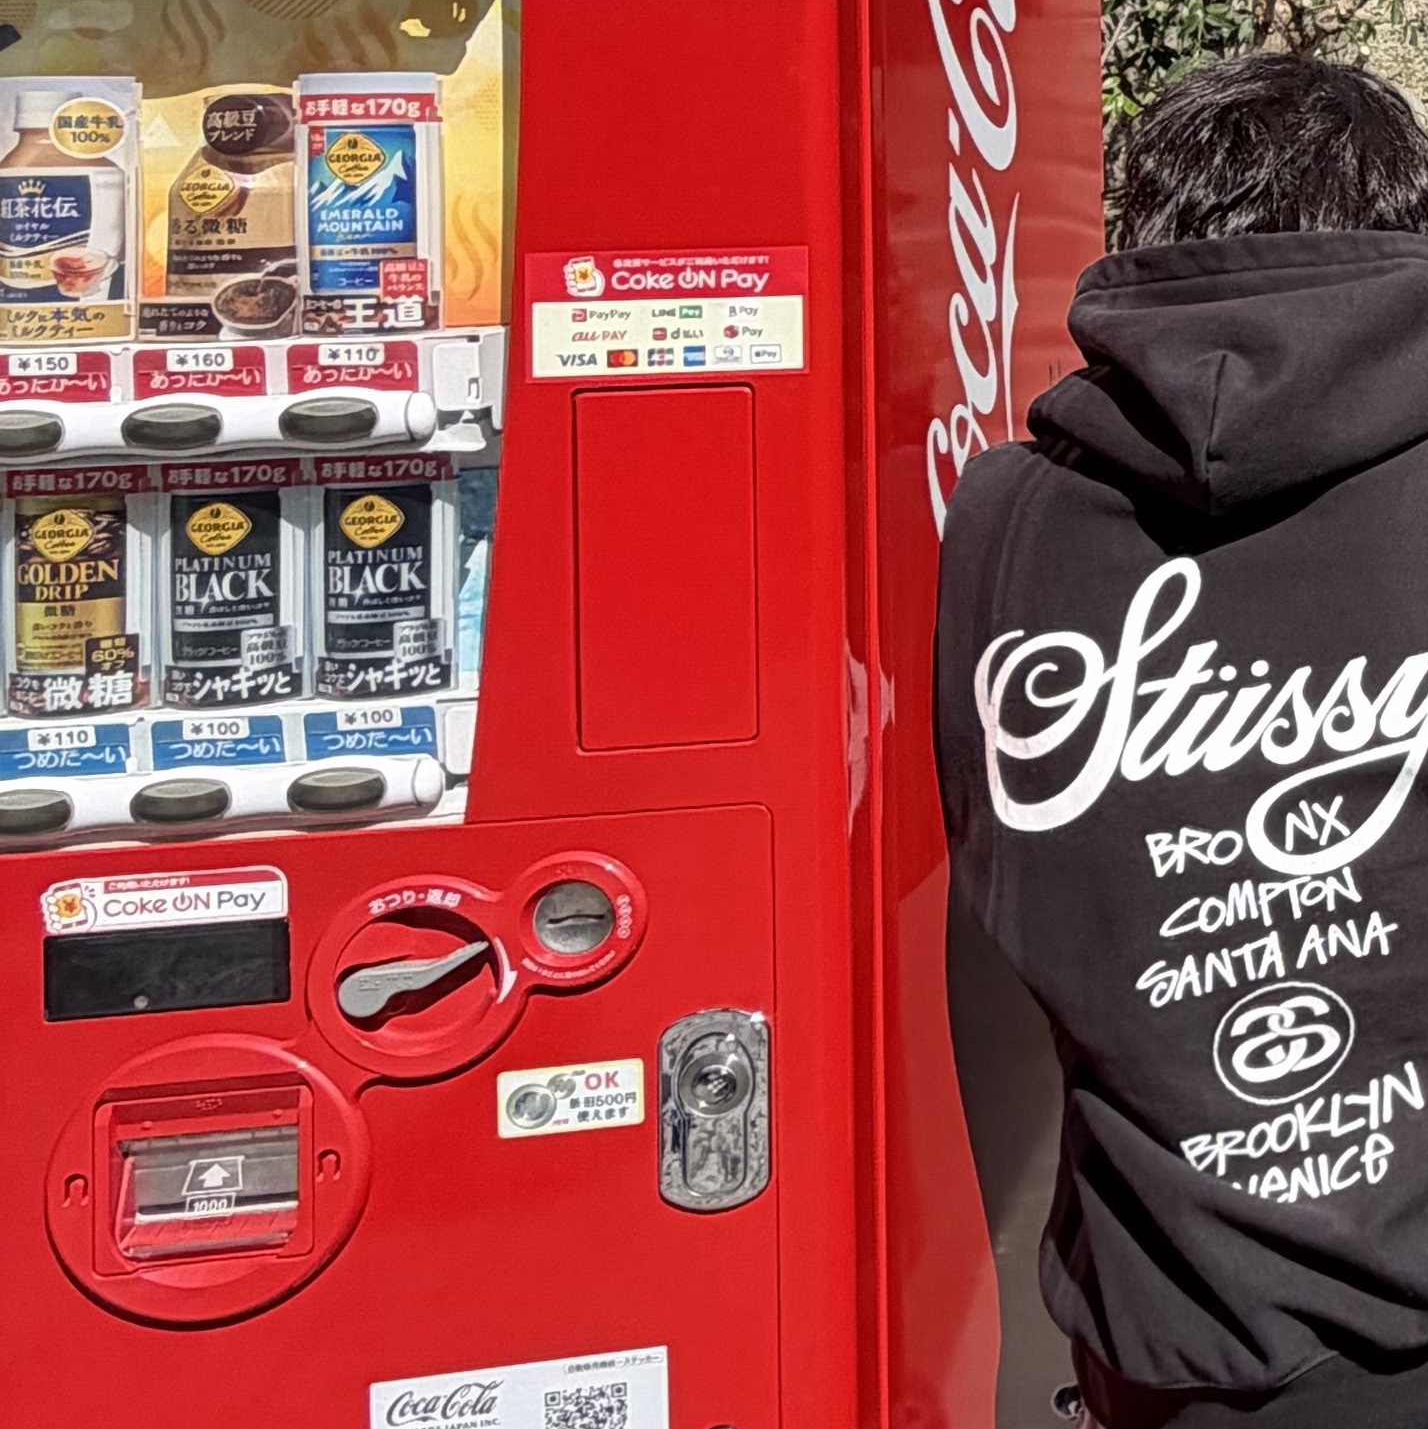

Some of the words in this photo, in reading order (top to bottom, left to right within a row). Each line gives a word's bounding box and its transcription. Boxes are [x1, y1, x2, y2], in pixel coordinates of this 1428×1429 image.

[70, 130, 112, 144] 100%
[208, 128, 255, 142] ブレンド
[327, 152, 384, 165] GEORGIA
[319, 207, 400, 222] EMERALD
[316, 219, 404, 234] MOUNTAIN
[611, 270, 675, 290] Coke
[678, 266, 716, 289] ON
[720, 269, 769, 293] Pay
[341, 294, 426, 329] 王道
[588, 309, 632, 322] PayPay
[651, 307, 677, 318] LINE
[681, 307, 700, 318] Pay
[739, 305, 759, 317] Pay
[602, 330, 628, 341] PAY
[741, 325, 764, 339] Pay
[175, 353, 226, 369] ¥160
[328, 347, 381, 362] ¥110
[555, 353, 599, 367] VISA
[17, 356, 70, 372] ¥150
[190, 521, 245, 534] GEORGIA
[344, 514, 398, 527] GEORGIA
[35, 528, 90, 540] GEORGIA
[174, 552, 273, 573] PLATINUM
[327, 545, 424, 566] PLATINUM
[17, 558, 120, 586] GOLDEN
[328, 560, 428, 597] BLACK
[34, 583, 90, 602] DRIP
[175, 568, 275, 605] BLACK
[91, 646, 136, 664] 60%
[193, 666, 292, 702] シャキッと
[346, 658, 442, 693] シャキッと
[42, 670, 134, 712] 微糖
[344, 708, 394, 725] ¥100
[36, 728, 88, 746] ¥110
[190, 721, 240, 737] ¥100
[103, 896, 168, 918] Coke
[172, 891, 212, 913] ON
[216, 890, 267, 912] Pay
[1158, 866, 1363, 939] COMPTON
[1135, 932, 1286, 1009] SANTA
[1296, 911, 1399, 971] ANA
[583, 1070, 621, 1091] OK
[1180, 1061, 1425, 1177] BROOKLYN
[192, 1197, 229, 1215] 1000
[386, 1379, 504, 1428] Coca-Cola
